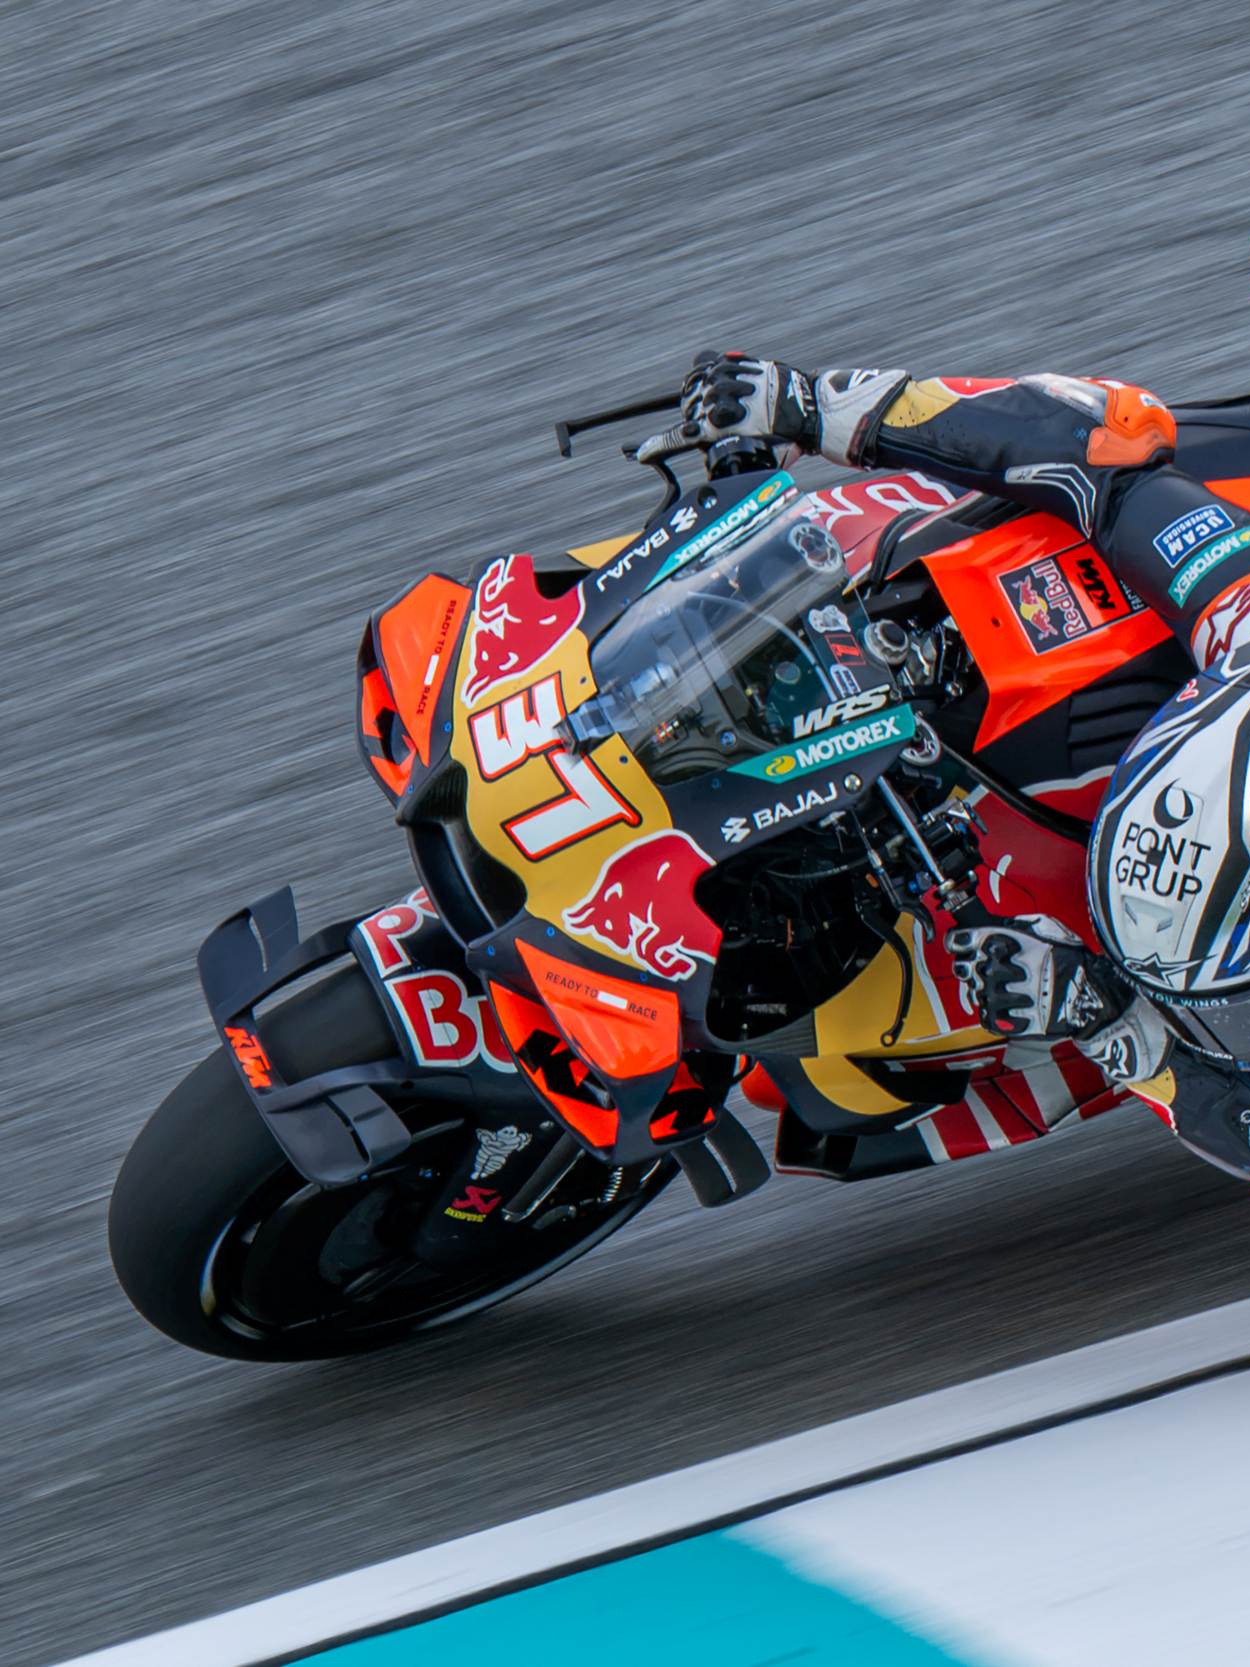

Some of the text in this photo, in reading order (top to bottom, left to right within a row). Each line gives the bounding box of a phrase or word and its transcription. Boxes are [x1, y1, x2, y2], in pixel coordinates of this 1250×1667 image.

[674, 497, 758, 563] MOTOREX
[1168, 516, 1224, 556] UCAM
[596, 525, 671, 591] BAJAJ
[1076, 558, 1116, 610] KTM
[1173, 537, 1241, 600] MOTOREX
[793, 684, 889, 739] WRS
[467, 670, 642, 861] 37
[796, 715, 901, 769] MOTOREX
[753, 781, 838, 831] BAJAJ
[1121, 820, 1212, 872] PONT
[1116, 857, 1203, 904] GRUP
[546, 972, 658, 1021] READY TO RACE
[1180, 996, 1230, 1008] WINGS
[224, 1027, 274, 1092] KTM
